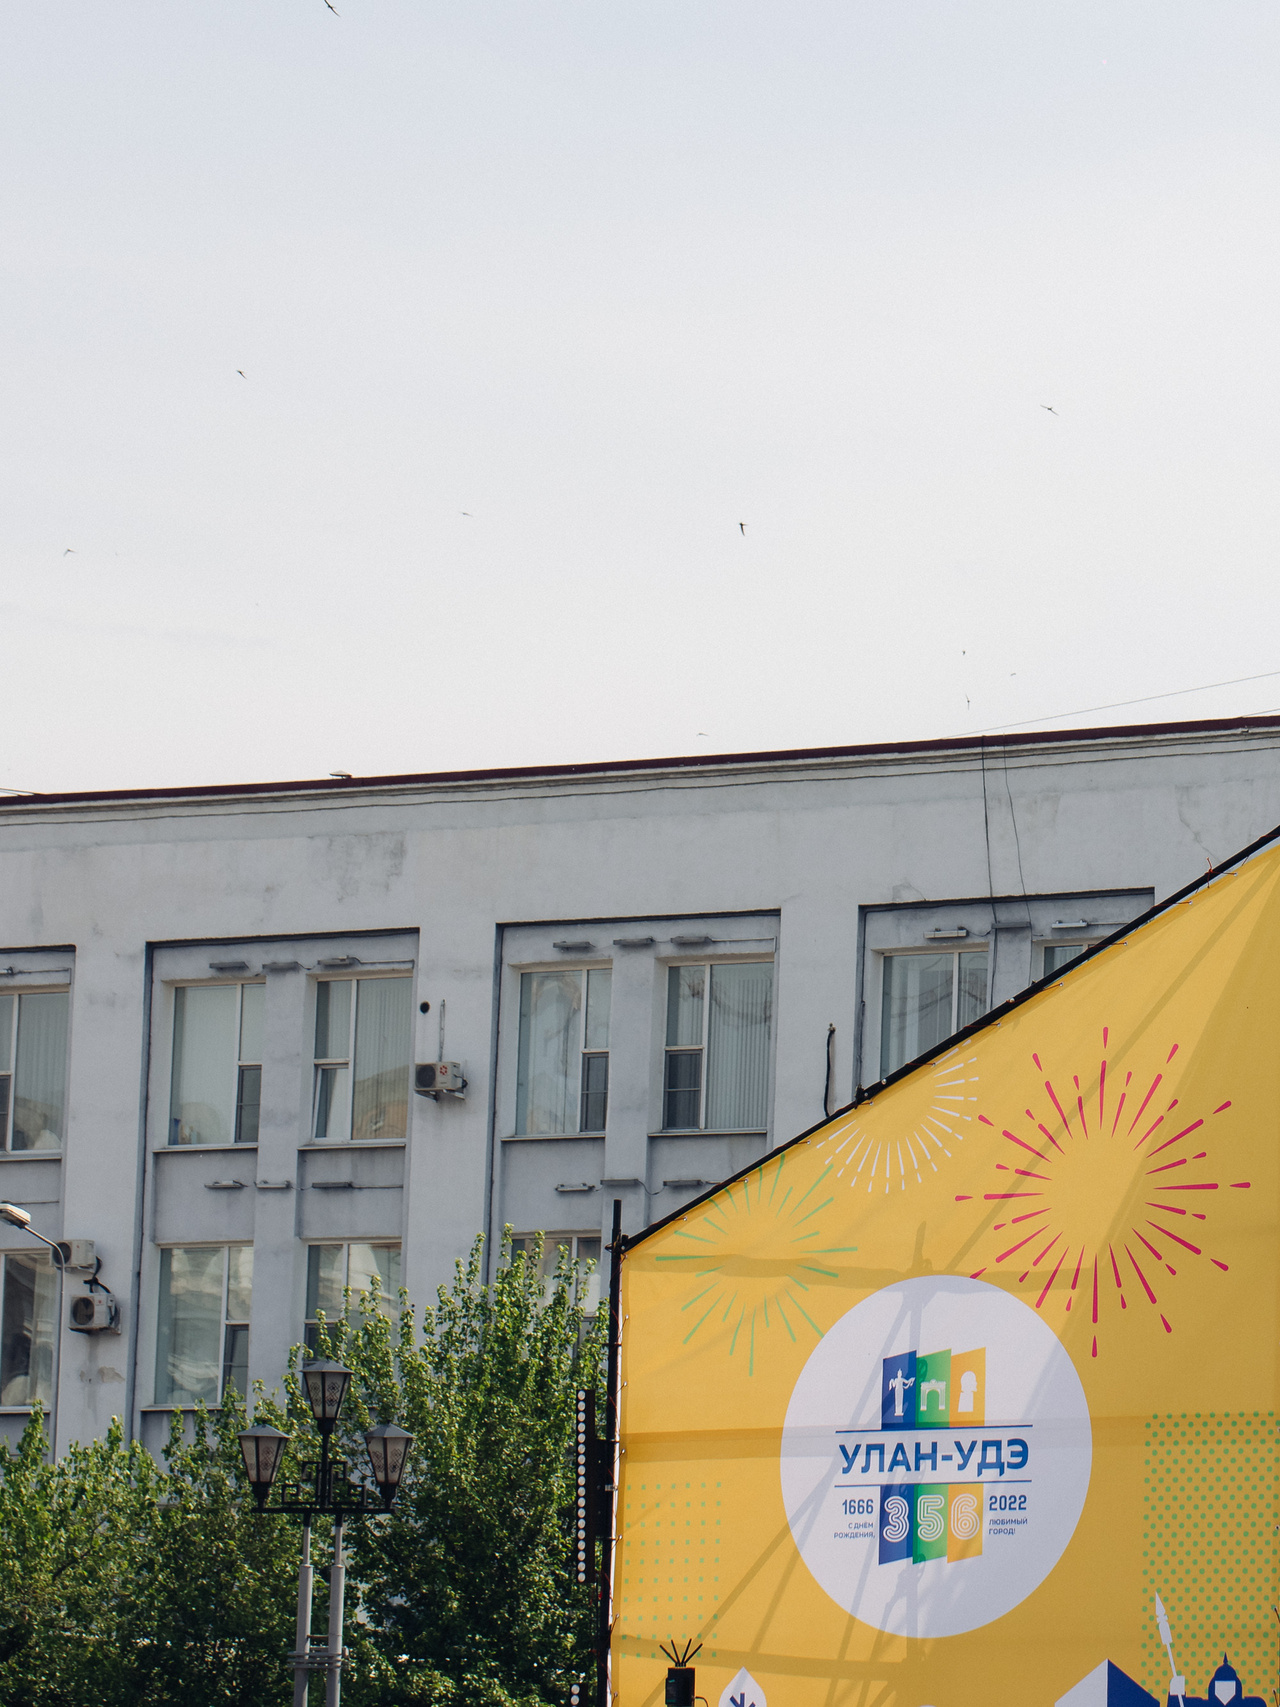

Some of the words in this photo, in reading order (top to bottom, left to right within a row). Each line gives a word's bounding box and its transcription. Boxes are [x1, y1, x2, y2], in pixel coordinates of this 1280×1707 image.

[838, 1438, 1030, 1477] УЛАН-УДЭ
[842, 1499, 874, 1515] 1666
[989, 1495, 1027, 1511] 2022
[883, 1493, 980, 1543] 356
[989, 1517, 1028, 1526] ЛЮБИМЫЙ
[853, 1521, 874, 1530] ДНЁМ
[834, 1531, 875, 1539] РОЖДЕНИЯ,
[988, 1528, 1016, 1536] ГОРОД!
